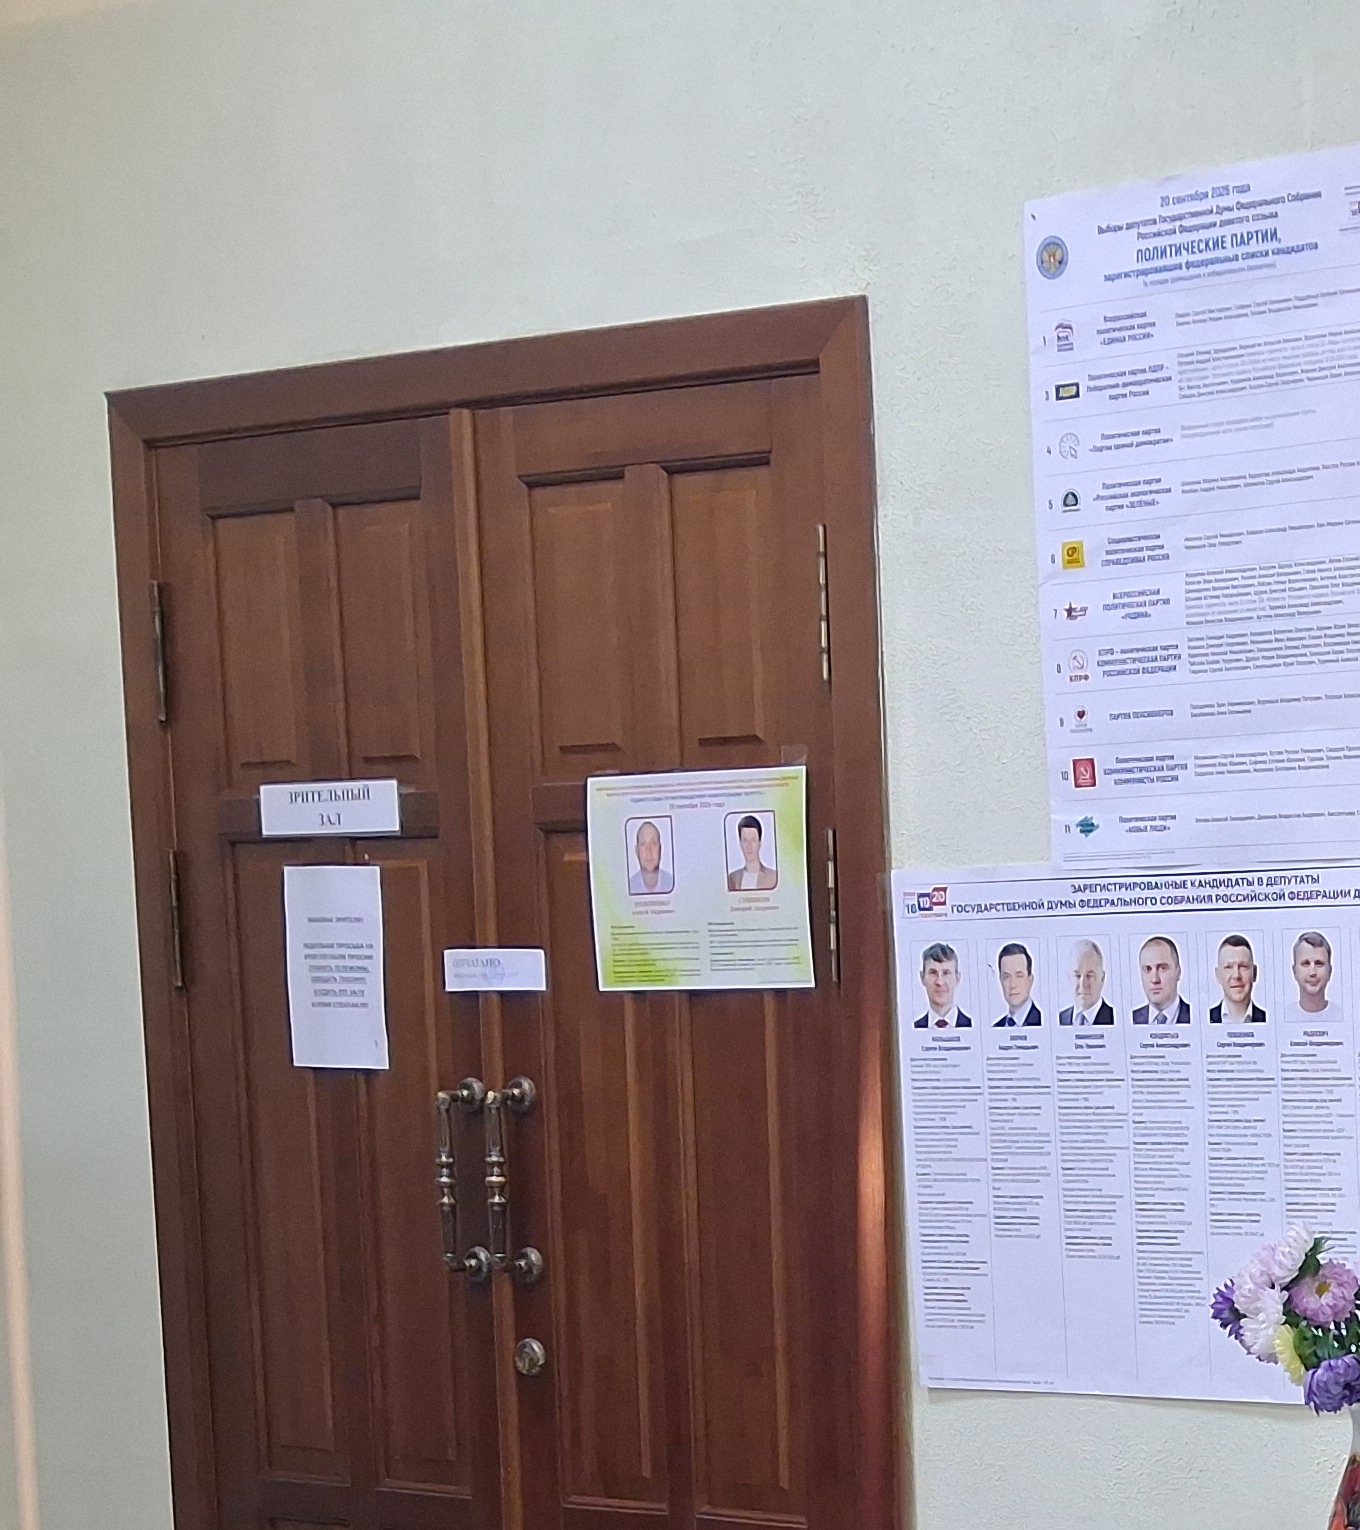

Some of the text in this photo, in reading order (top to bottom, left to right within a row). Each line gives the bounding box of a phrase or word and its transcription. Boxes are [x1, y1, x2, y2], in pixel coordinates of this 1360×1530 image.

[1136, 227, 1281, 263] ПОЛИТИЧЕСКИЕ ПАРТИИ,
[289, 784, 370, 804] ЗРИТЕЛЬНЫЙ
[319, 812, 341, 826] ЗАЛ
[1070, 874, 1320, 894] ЗАРЕГИСТРИРОВАННЫЕ КАНДИДАТЫ В ДЕПУТАТЫ
[951, 897, 1045, 914] ГОСУДАРСТВЕННОЙ
[1046, 898, 1077, 911] ДУМЫ
[1078, 896, 1157, 910] ФЕДЕРАЛЬНОГО
[1159, 894, 1214, 907] СОБРАНИЯ
[1215, 890, 1286, 905] РОССИЙСКОЙ
[1287, 888, 1351, 901] ФЕДЕРАЦИИ
